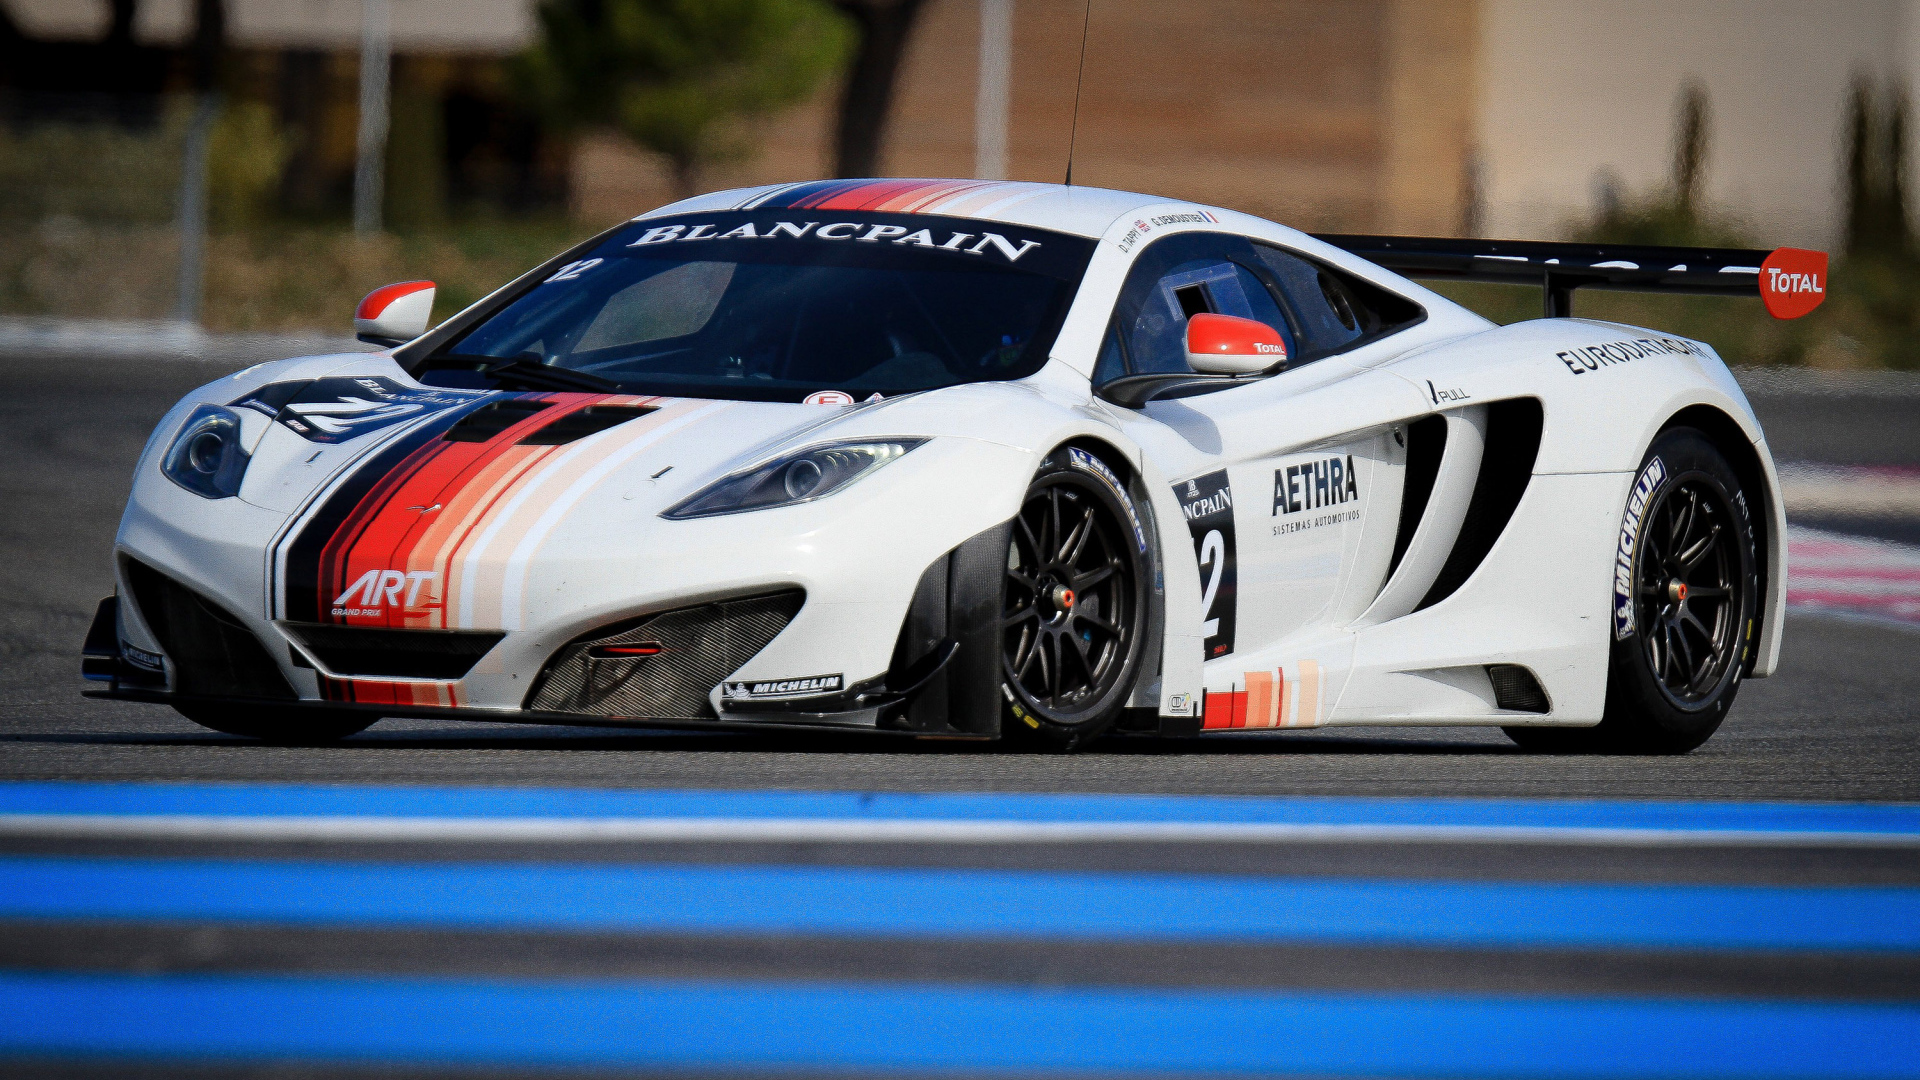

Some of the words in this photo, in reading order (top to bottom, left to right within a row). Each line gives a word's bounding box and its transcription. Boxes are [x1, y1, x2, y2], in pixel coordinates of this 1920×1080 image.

[626, 221, 1041, 262] BLANCPAIN
[1123, 228, 1141, 247] TAPPY
[543, 257, 604, 284] 12
[1556, 338, 1712, 375] EURODATACAR
[1437, 387, 1471, 402] PULL
[1272, 454, 1358, 516] AETHRA
[1273, 519, 1311, 536] SISTEMAS
[1314, 509, 1360, 528] AUTOMOTIVOS
[1615, 459, 1662, 598] MICHELIN
[332, 569, 440, 607] ART
[331, 608, 360, 616] GRAND
[361, 609, 381, 617] PRIX
[753, 676, 840, 693] MICHELIN
